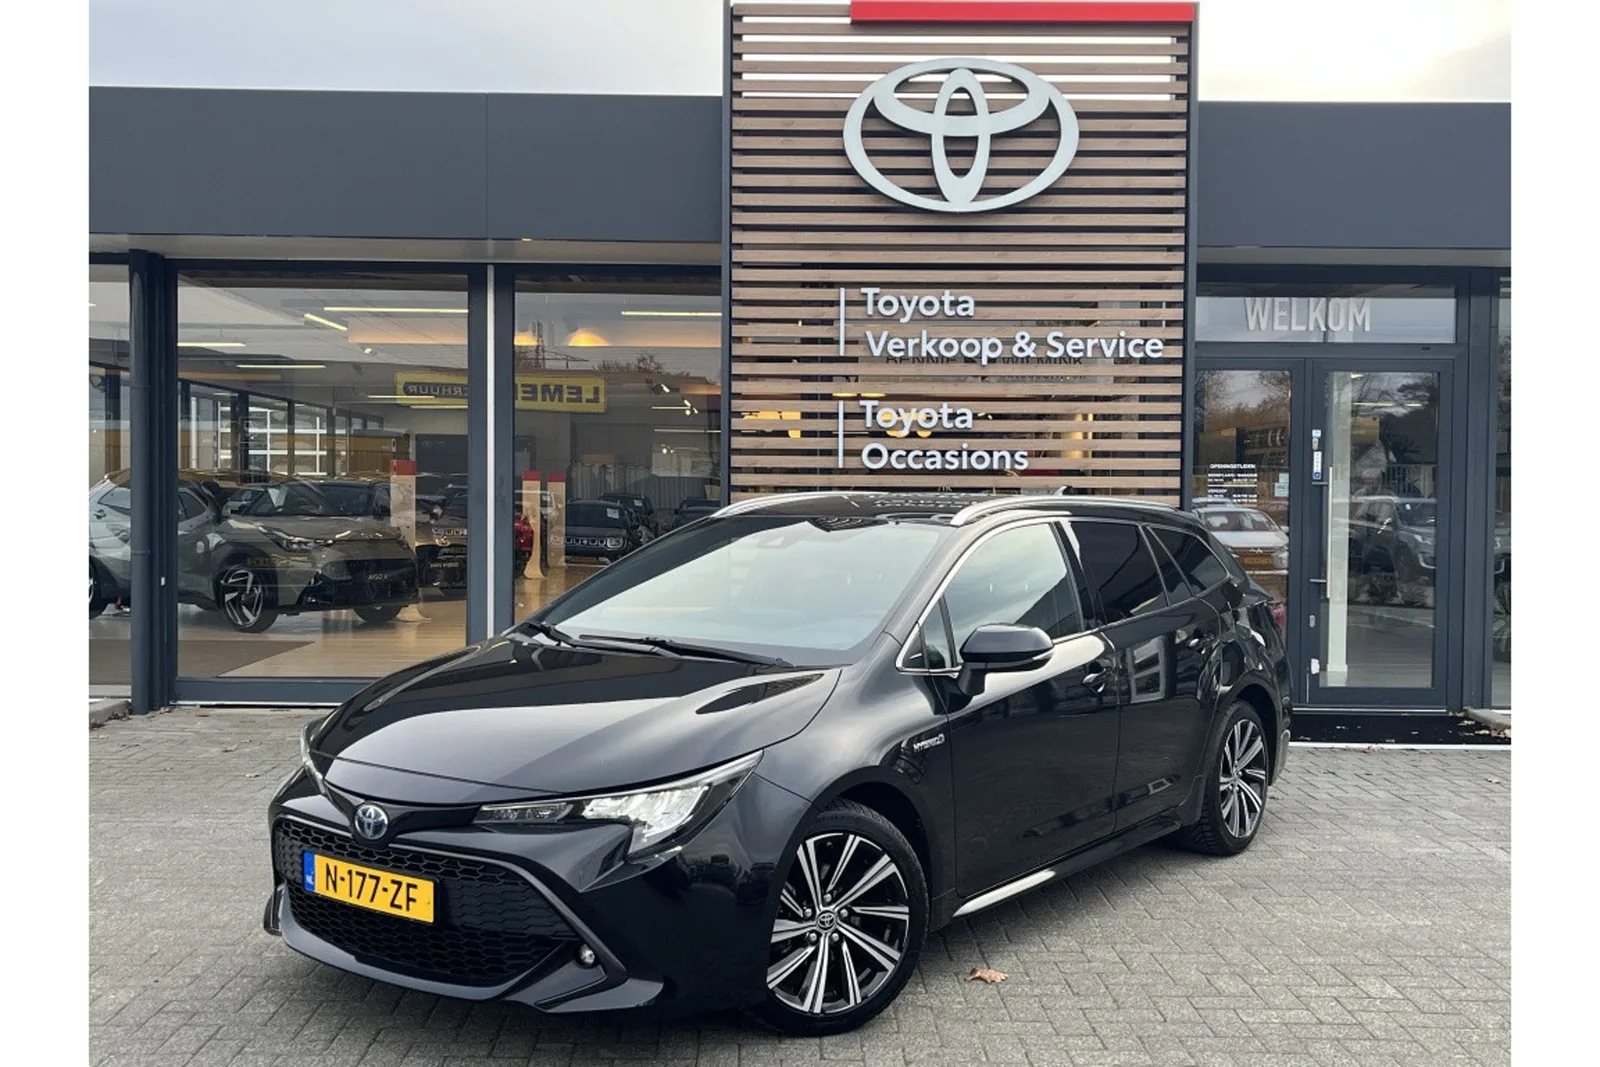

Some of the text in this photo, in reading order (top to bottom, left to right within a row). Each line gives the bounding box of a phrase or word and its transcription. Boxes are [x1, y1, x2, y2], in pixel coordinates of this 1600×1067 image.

[860, 287, 975, 323] Toyota
[1244, 297, 1371, 332] WELKOM
[864, 329, 1164, 366] Verkoop & Service
[859, 400, 974, 438] Toyota
[861, 442, 1030, 470] Occasions
[325, 861, 419, 912] N-177-ZF
